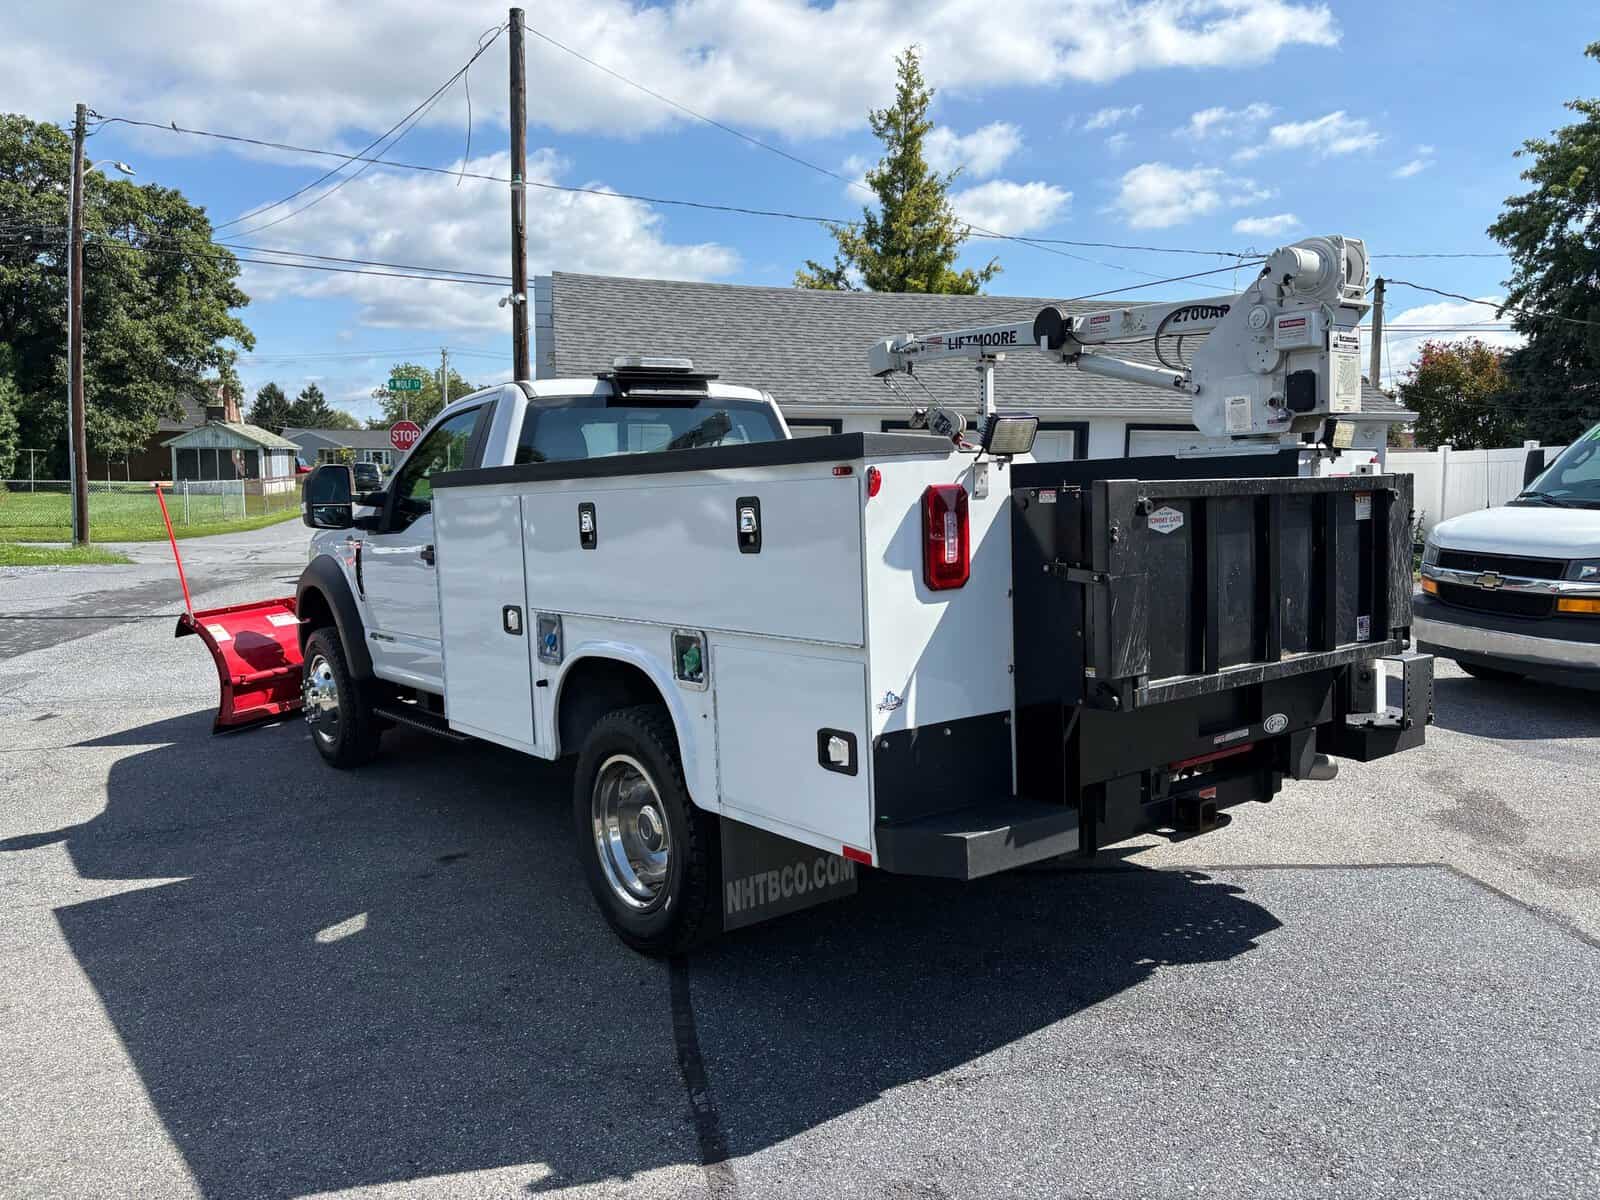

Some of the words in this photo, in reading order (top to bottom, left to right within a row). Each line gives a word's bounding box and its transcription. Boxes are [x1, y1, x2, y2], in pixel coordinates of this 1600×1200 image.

[948, 330, 1017, 350] LIFTMOORE
[392, 430, 419, 442] STOP
[726, 854, 855, 914] NHTBCO.COM
